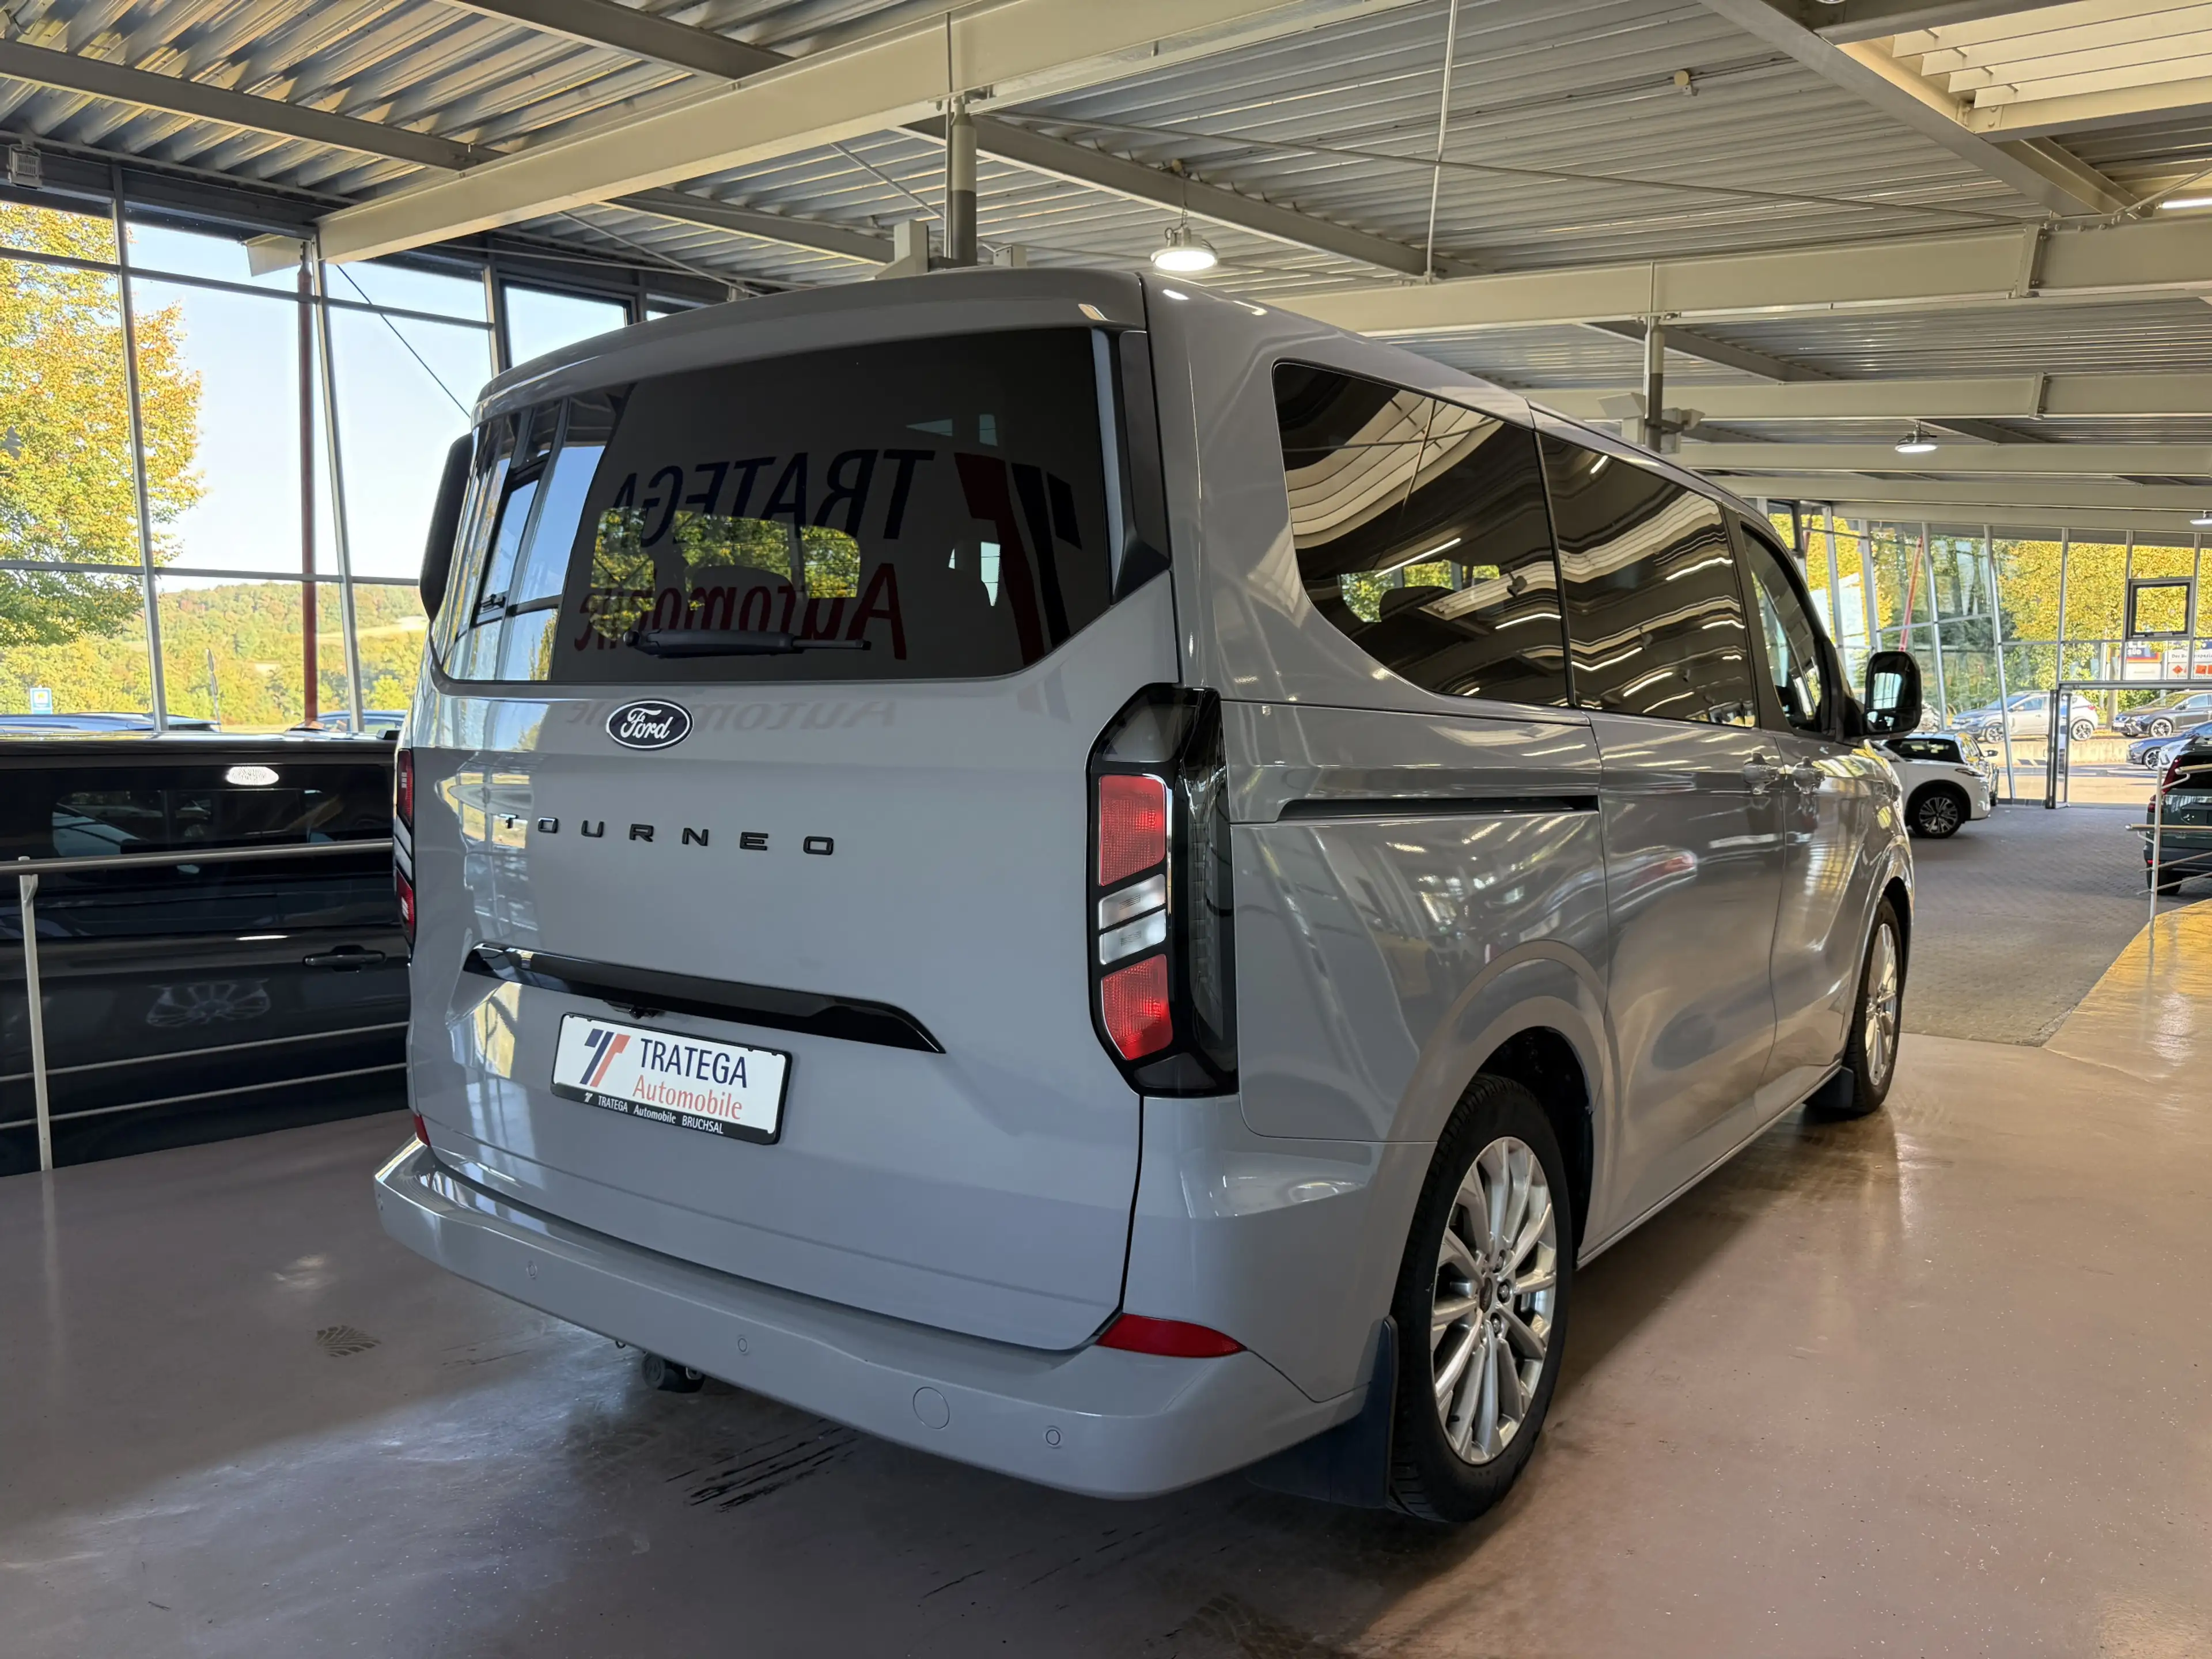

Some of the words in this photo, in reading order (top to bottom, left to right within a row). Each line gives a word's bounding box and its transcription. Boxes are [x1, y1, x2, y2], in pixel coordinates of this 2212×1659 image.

[620, 707, 670, 740] Ford
[499, 813, 834, 856] TOURNEO
[640, 1038, 747, 1088] TRATEGA
[598, 1095, 628, 1113] TRATEGA
[634, 1104, 676, 1124] Automobile
[681, 1115, 724, 1134] BRUCHSAL
[632, 1074, 743, 1120] Automobile
